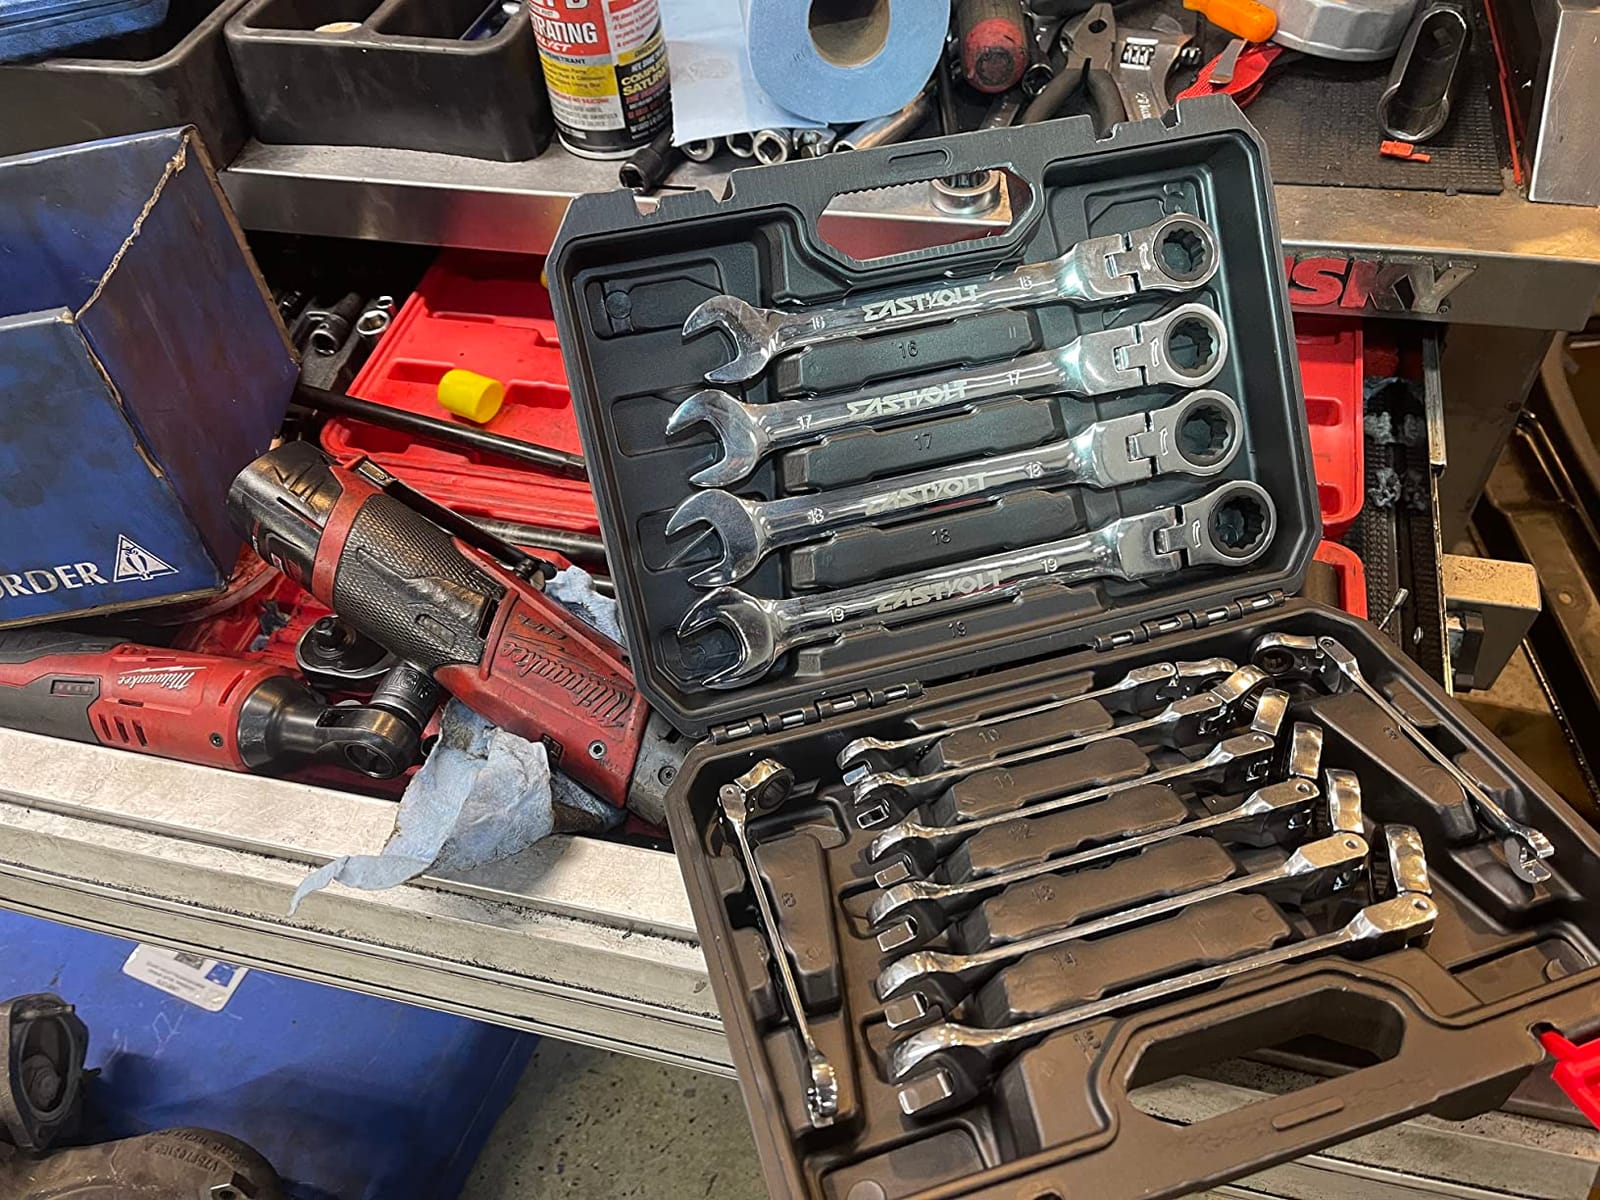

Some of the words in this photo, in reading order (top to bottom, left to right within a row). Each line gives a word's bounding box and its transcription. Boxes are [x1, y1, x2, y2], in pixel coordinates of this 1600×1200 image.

[1283, 256, 1476, 314] SKY
[861, 284, 978, 322] EASTVOLT
[899, 340, 919, 359] 16
[1007, 370, 1021, 386] 17
[846, 380, 968, 418] EASTVOLT
[797, 414, 812, 431] 17
[913, 433, 933, 450] 17
[864, 472, 987, 516] EASTVOLT
[931, 528, 952, 546] 18
[1040, 558, 1059, 574] 19
[877, 569, 1002, 614] EASTVOLT
[827, 607, 845, 623] 19
[947, 621, 967, 639] 19
[117, 671, 196, 691] Milwaukee
[502, 641, 633, 728] Milwaukee
